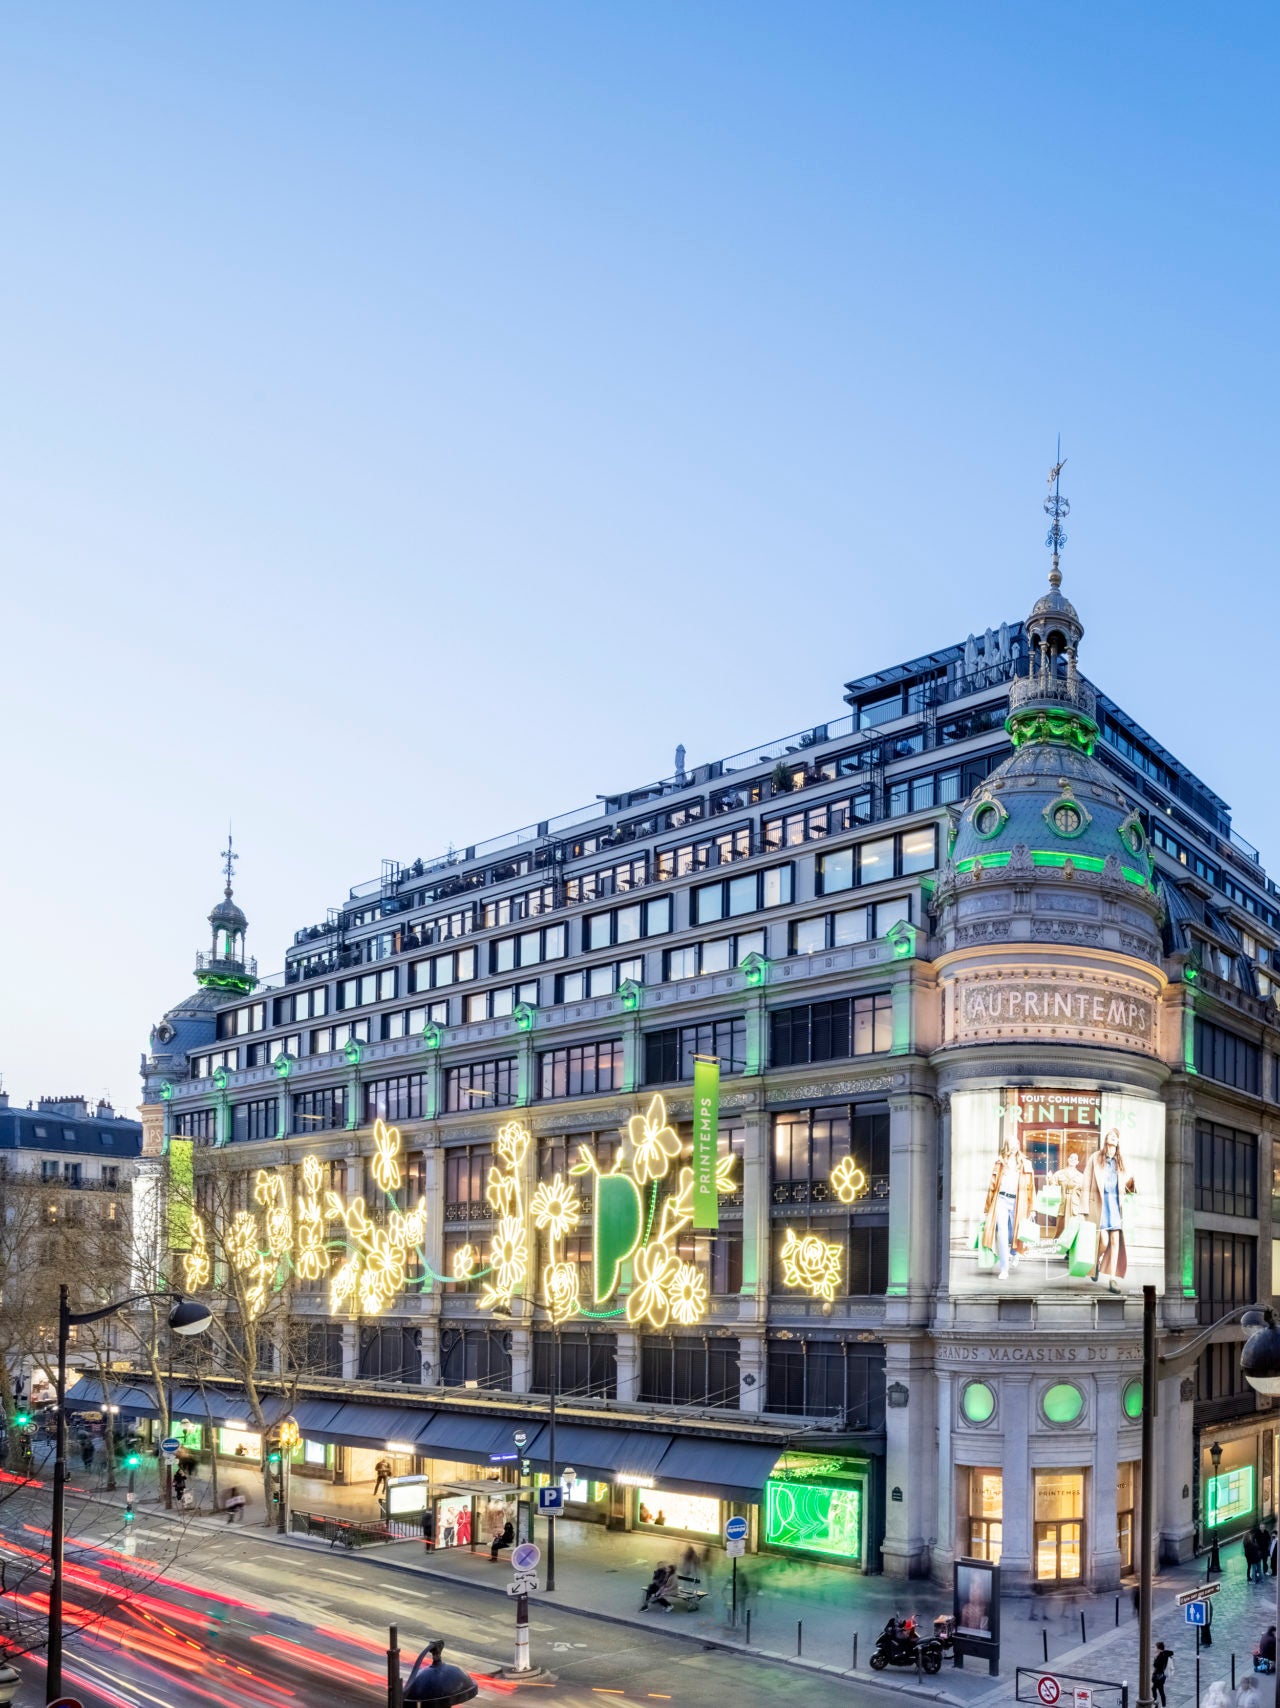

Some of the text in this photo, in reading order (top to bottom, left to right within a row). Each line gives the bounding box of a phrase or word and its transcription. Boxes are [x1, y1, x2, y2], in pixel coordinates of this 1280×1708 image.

[972, 991, 1147, 1031] AU PRINTEMPS
[1021, 1095, 1046, 1103] TOUT
[1048, 1096, 1101, 1106] COMMENCE
[699, 1098, 712, 1194] PRINTEMPS
[989, 1348, 1077, 1361] MAGASINS
[1088, 1347, 1108, 1361] DU
[544, 1489, 557, 1506] P
